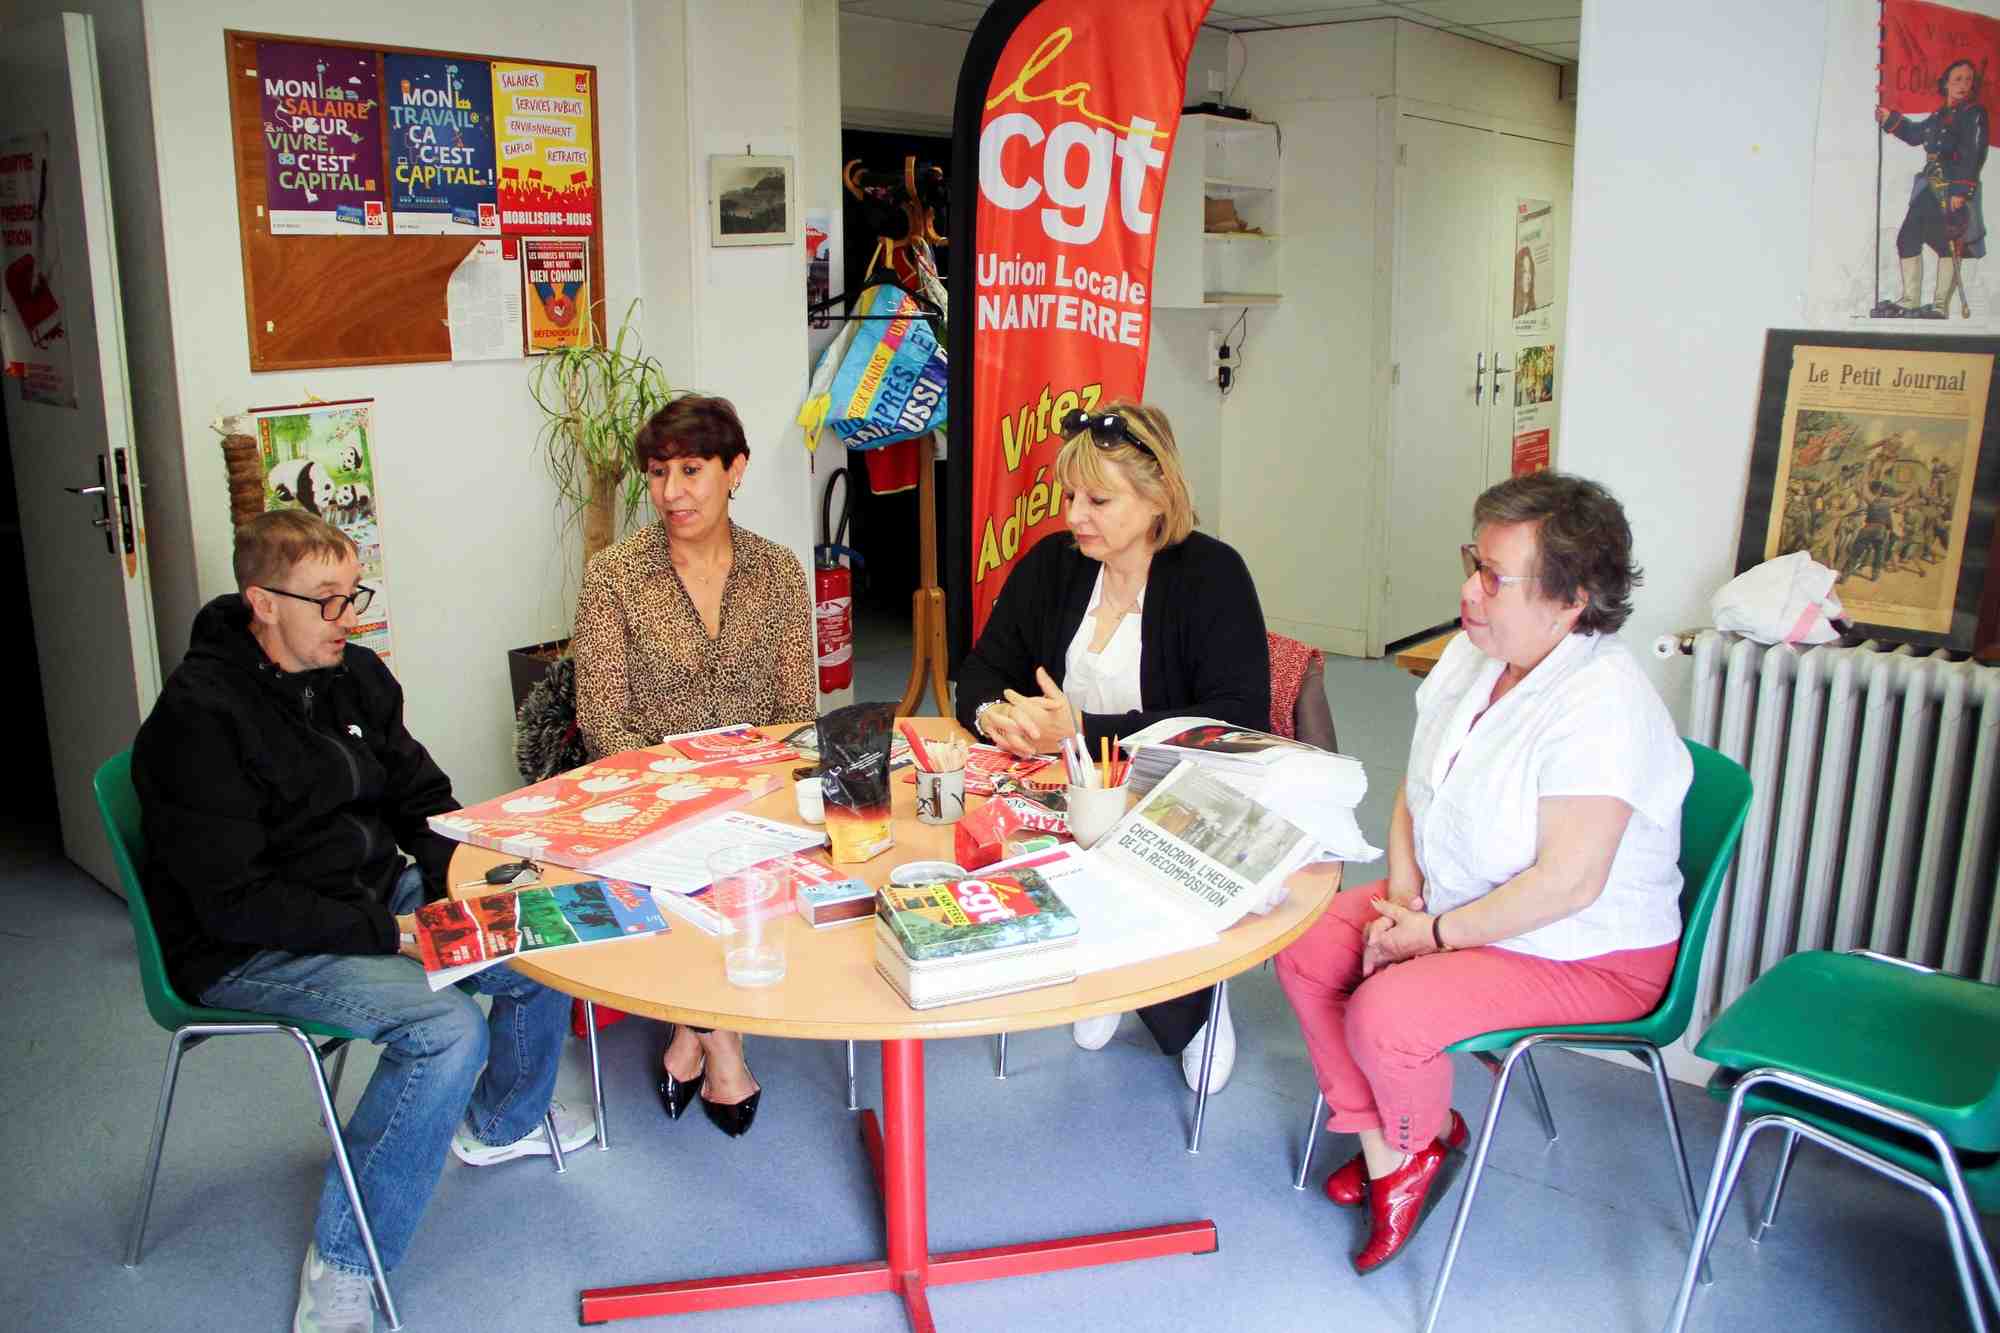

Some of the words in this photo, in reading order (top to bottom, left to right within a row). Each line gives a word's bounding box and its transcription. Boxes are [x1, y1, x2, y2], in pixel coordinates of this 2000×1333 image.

[265, 79, 316, 97] MON
[502, 72, 539, 88] SALAIRES
[286, 98, 368, 119] SALAIRE
[403, 89, 452, 107] MON
[516, 98, 550, 112] SERVICES
[553, 100, 582, 114] PUBLICS
[292, 116, 353, 136] POUR
[390, 106, 473, 128] TRAVAIL
[409, 125, 436, 148] ÇA
[511, 120, 571, 137] ENVIRONNEMENT
[266, 133, 334, 154] VIVRE,
[298, 153, 353, 172] C'EST
[420, 146, 474, 165] C'EST
[547, 150, 587, 163] RETRAITES
[979, 113, 1164, 244] cgt
[502, 210, 592, 226] MOBILISONS-NOUS
[551, 270, 583, 282] COMMUN
[977, 253, 1046, 287] Union
[1055, 255, 1146, 305] Locale
[977, 294, 1142, 347] NANTERRE
[864, 354, 888, 393] MAINS
[1808, 362, 1830, 383] Le
[1840, 364, 1881, 387] Petit
[1892, 367, 1968, 391] Journal
[899, 377, 943, 433] USSI
[1129, 823, 1159, 844] CHEZ
[1153, 838, 1200, 872] MACRON,
[1196, 863, 1245, 897] L'HEURE
[1118, 834, 1133, 849] DE
[1131, 842, 1150, 858] LA
[1145, 851, 1230, 908] RECOMPOSITION
